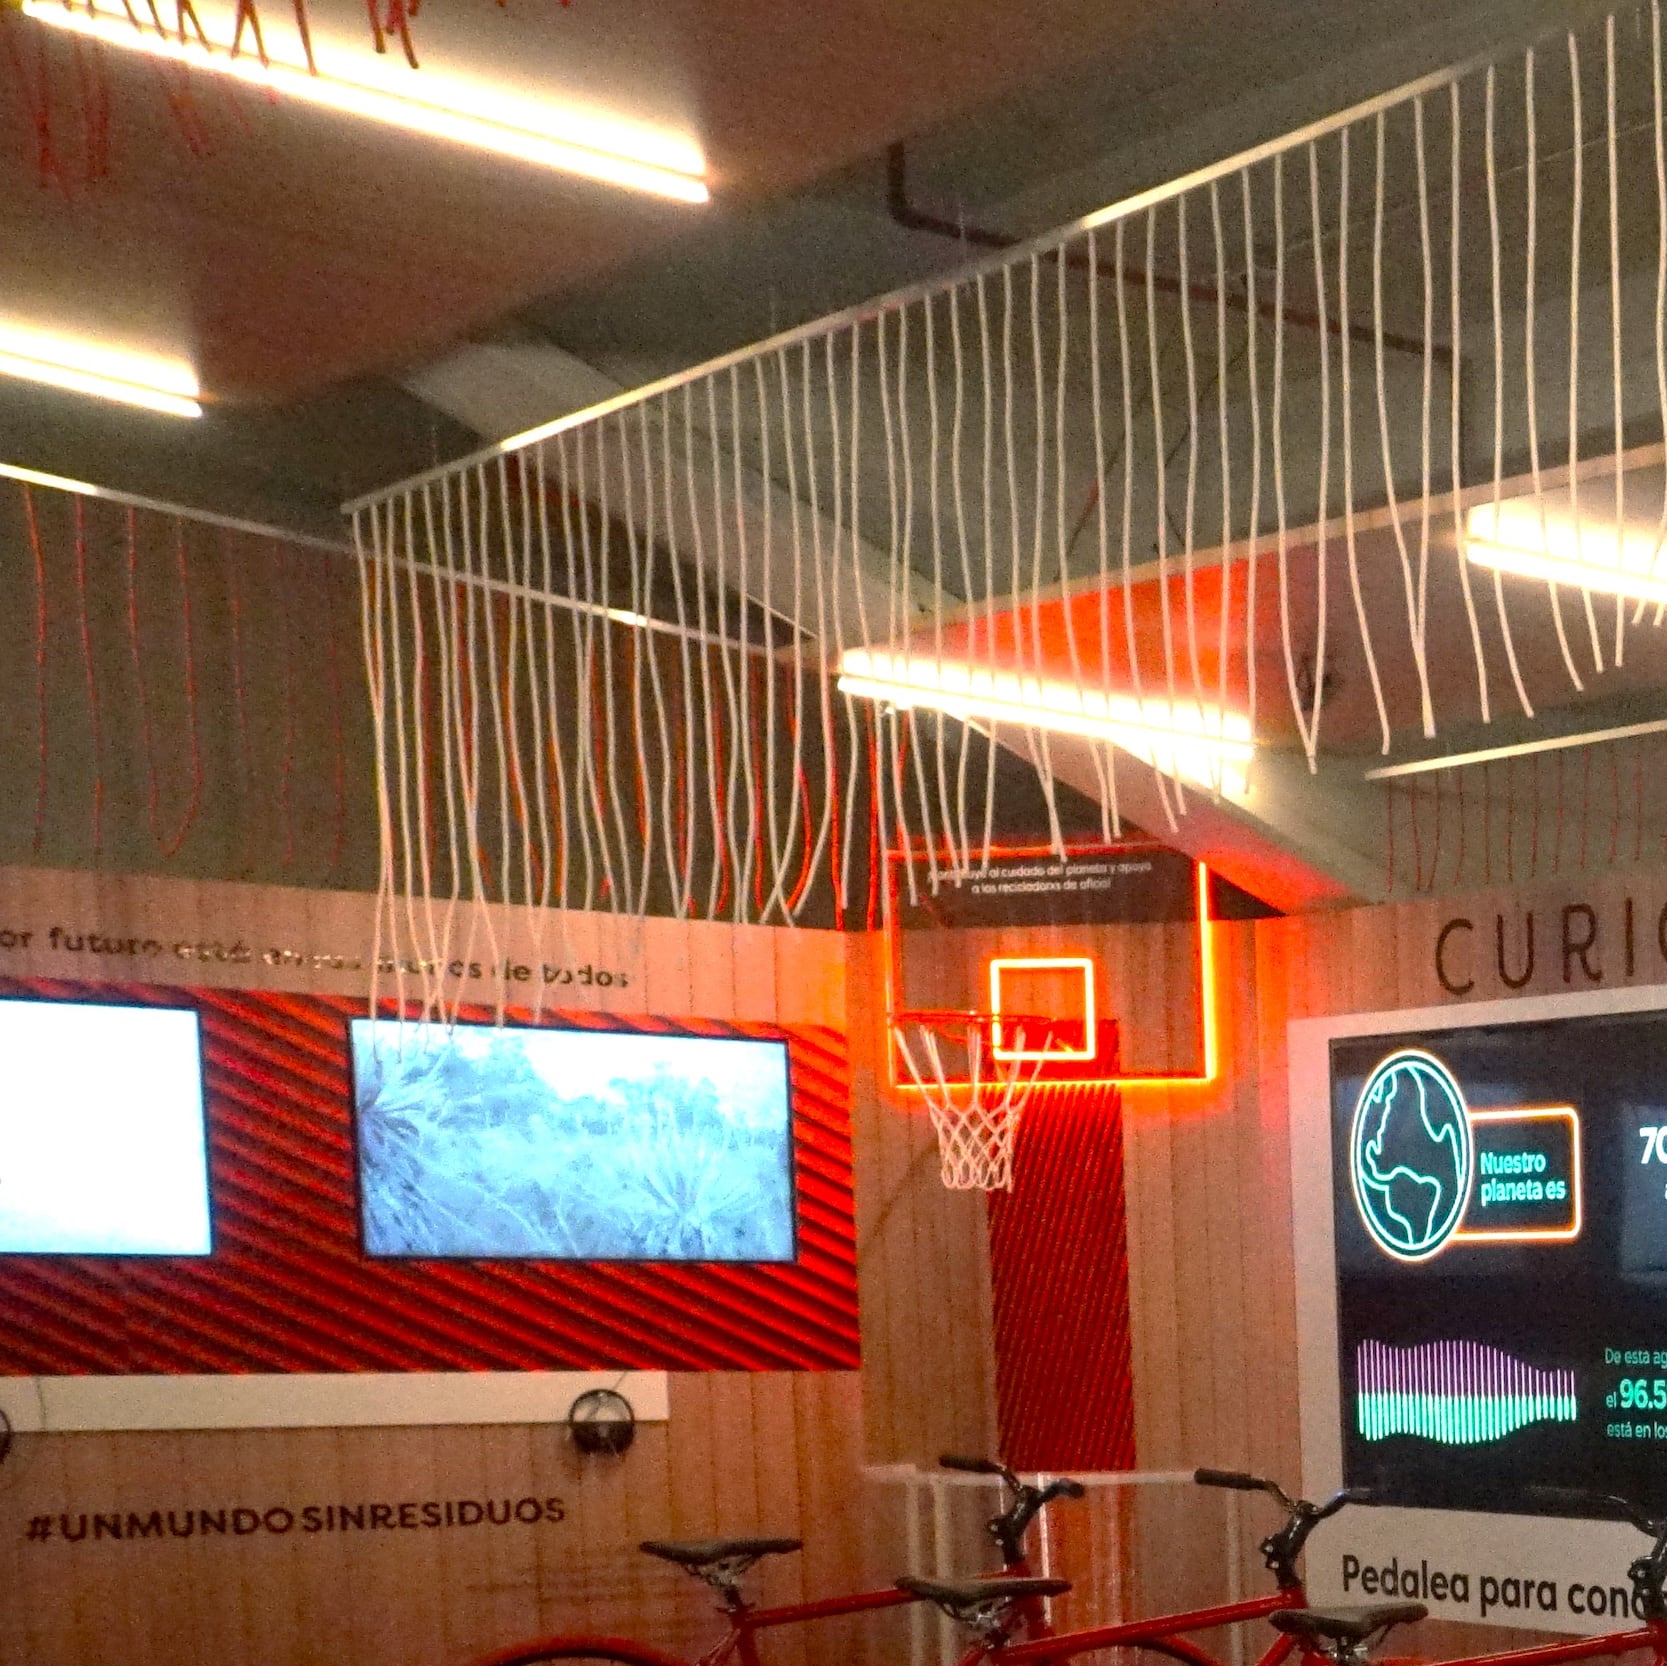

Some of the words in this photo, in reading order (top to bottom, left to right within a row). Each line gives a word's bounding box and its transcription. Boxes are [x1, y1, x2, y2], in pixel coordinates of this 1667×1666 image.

[1001, 865, 1045, 879] cuidado
[1066, 863, 1108, 879] planeta
[49, 927, 162, 957] futuro
[1480, 1151, 1546, 1175] Nuestro
[1481, 1178, 1543, 1207] planeta
[1545, 1180, 1566, 1200] es
[1604, 1347, 1622, 1366] De
[1605, 1391, 1617, 1409] el
[1606, 1420, 1633, 1439] está
[1635, 1424, 1651, 1440] en
[1342, 1553, 1470, 1604] Pedalea
[1480, 1574, 1557, 1618] para
